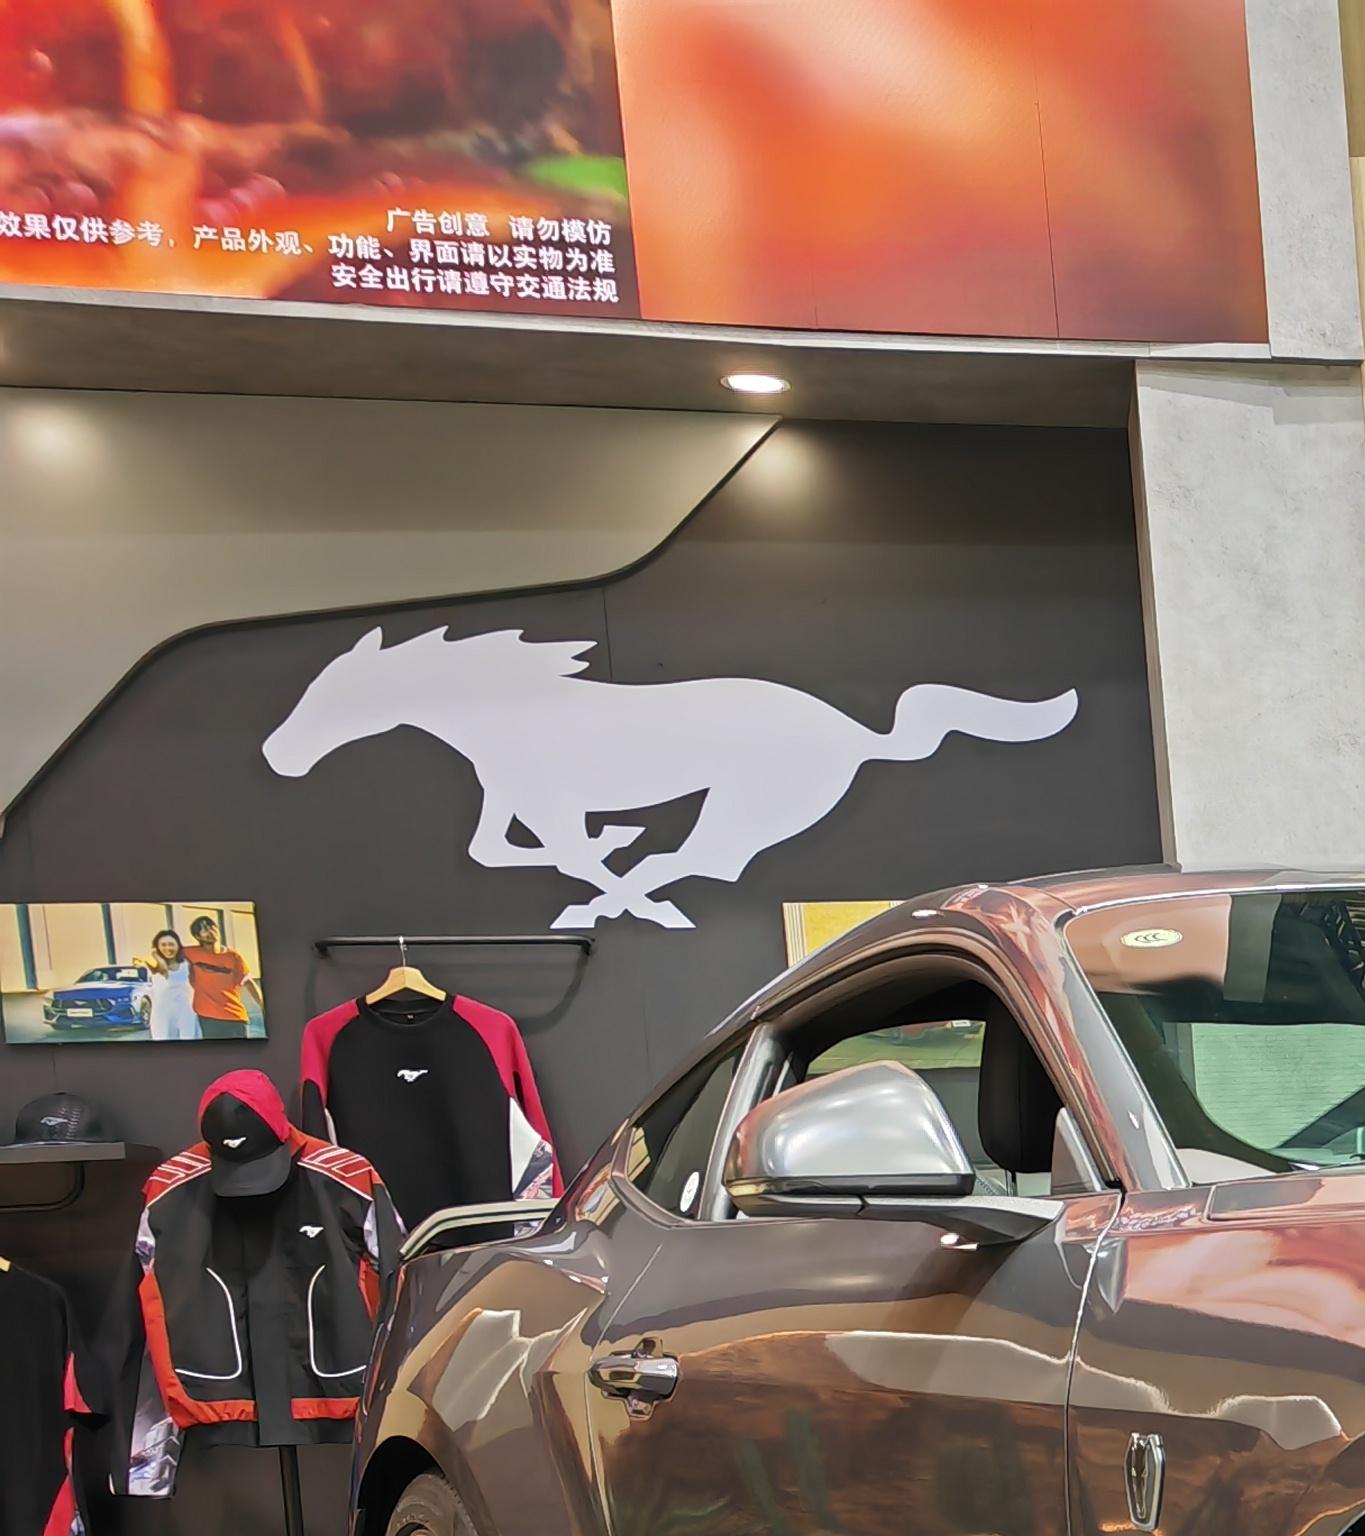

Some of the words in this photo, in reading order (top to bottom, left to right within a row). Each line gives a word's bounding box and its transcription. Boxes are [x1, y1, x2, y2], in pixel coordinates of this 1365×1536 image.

[387, 207, 490, 238] 广告创意
[508, 214, 612, 246] 请勿模仿
[331, 262, 620, 304] 安全出行请遵守交通法规
